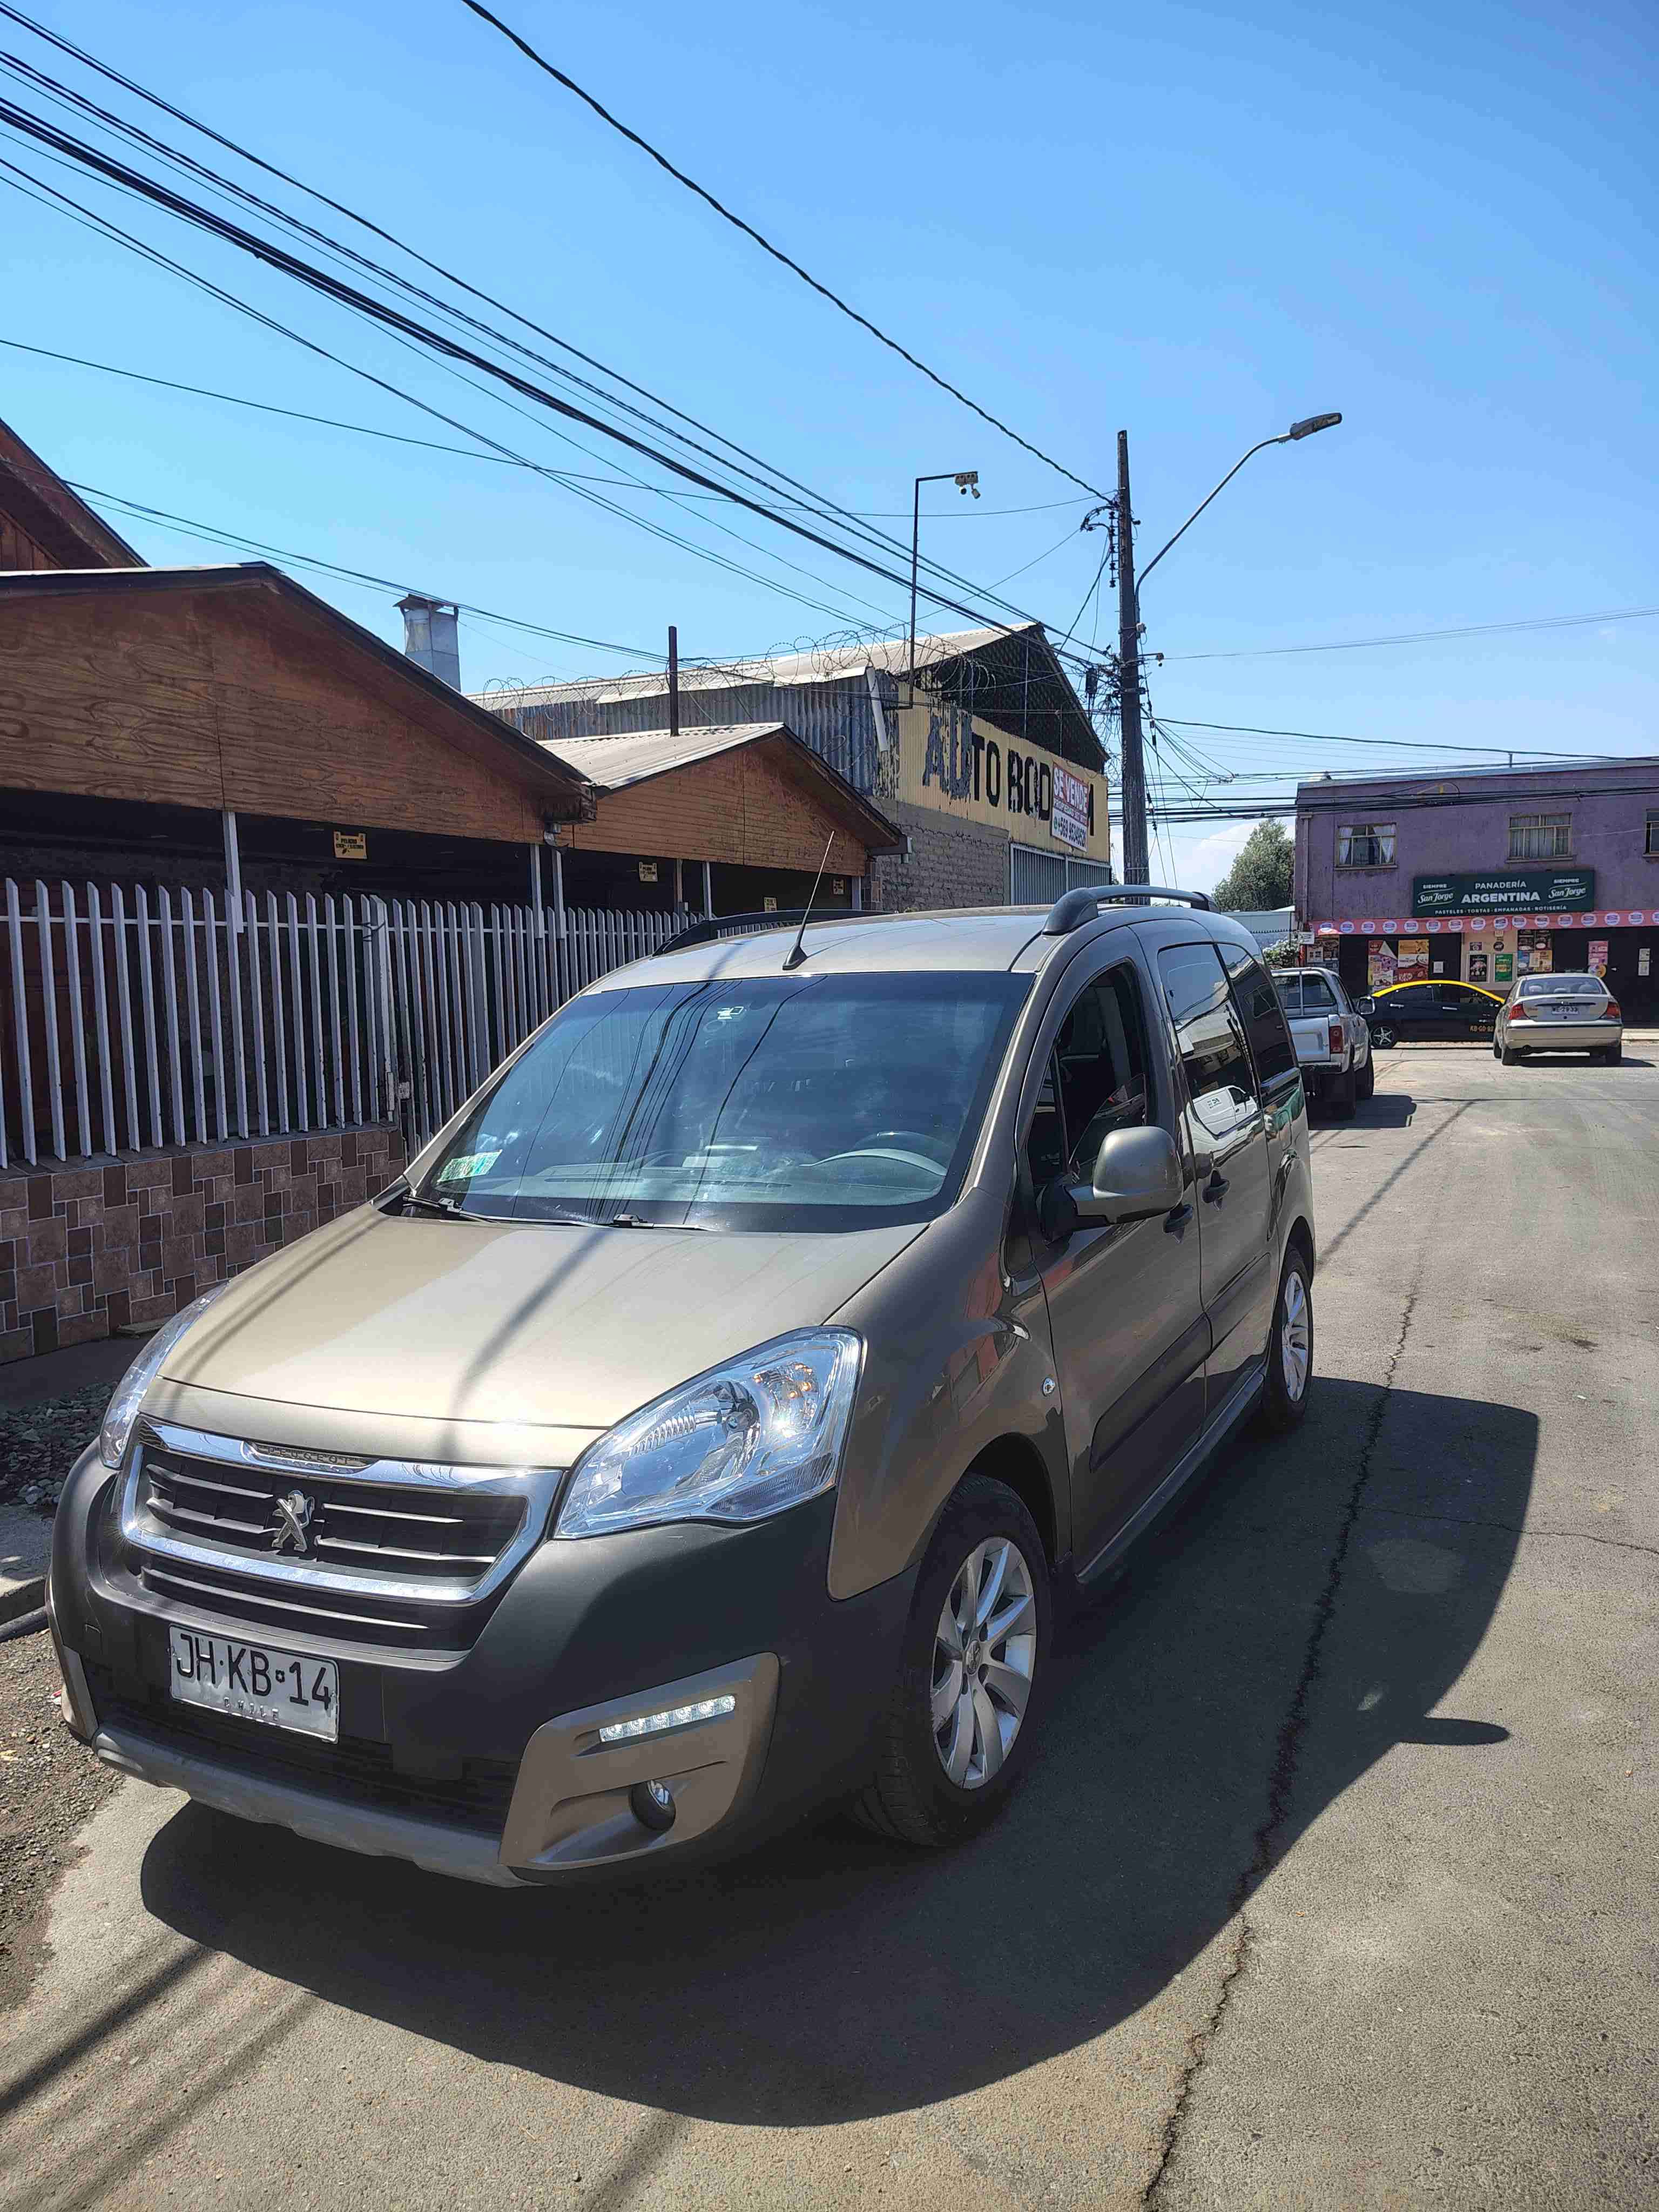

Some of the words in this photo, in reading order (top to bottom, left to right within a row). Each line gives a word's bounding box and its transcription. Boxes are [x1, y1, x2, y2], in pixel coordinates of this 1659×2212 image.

[922, 711, 1000, 807] AUTO
[1054, 767, 1064, 799] SE
[1065, 774, 1088, 813] VENDE
[1475, 880, 1527, 889] PANADERÍA
[1417, 894, 1433, 903] San
[1433, 892, 1454, 902] Jorge
[1461, 892, 1541, 904] ARGENTINA
[1548, 889, 1564, 898] San
[1565, 887, 1586, 897] Jorge
[268, 1446, 349, 1465] PEUGEOT
[224, 1696, 279, 1721] CHILE
